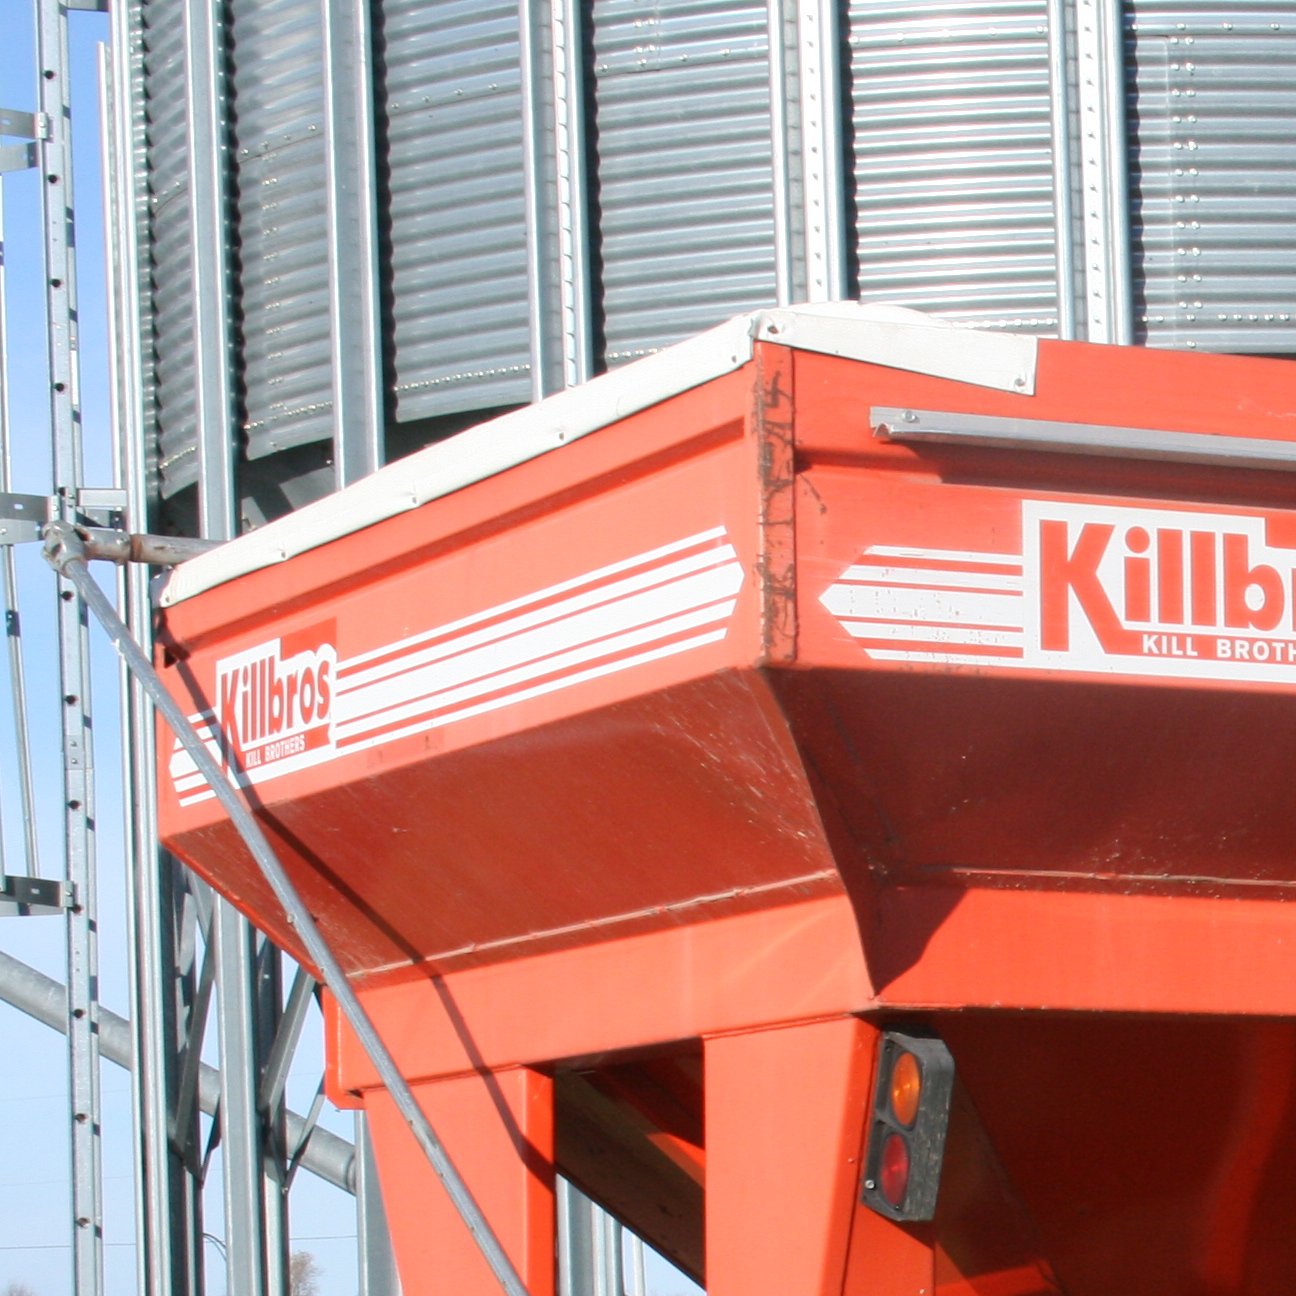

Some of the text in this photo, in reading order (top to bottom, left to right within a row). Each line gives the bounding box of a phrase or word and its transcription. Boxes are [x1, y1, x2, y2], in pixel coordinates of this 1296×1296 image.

[1142, 634, 1198, 657] KILL
[221, 655, 330, 773] Killbros
[245, 734, 306, 769] KILL BROTHERS
